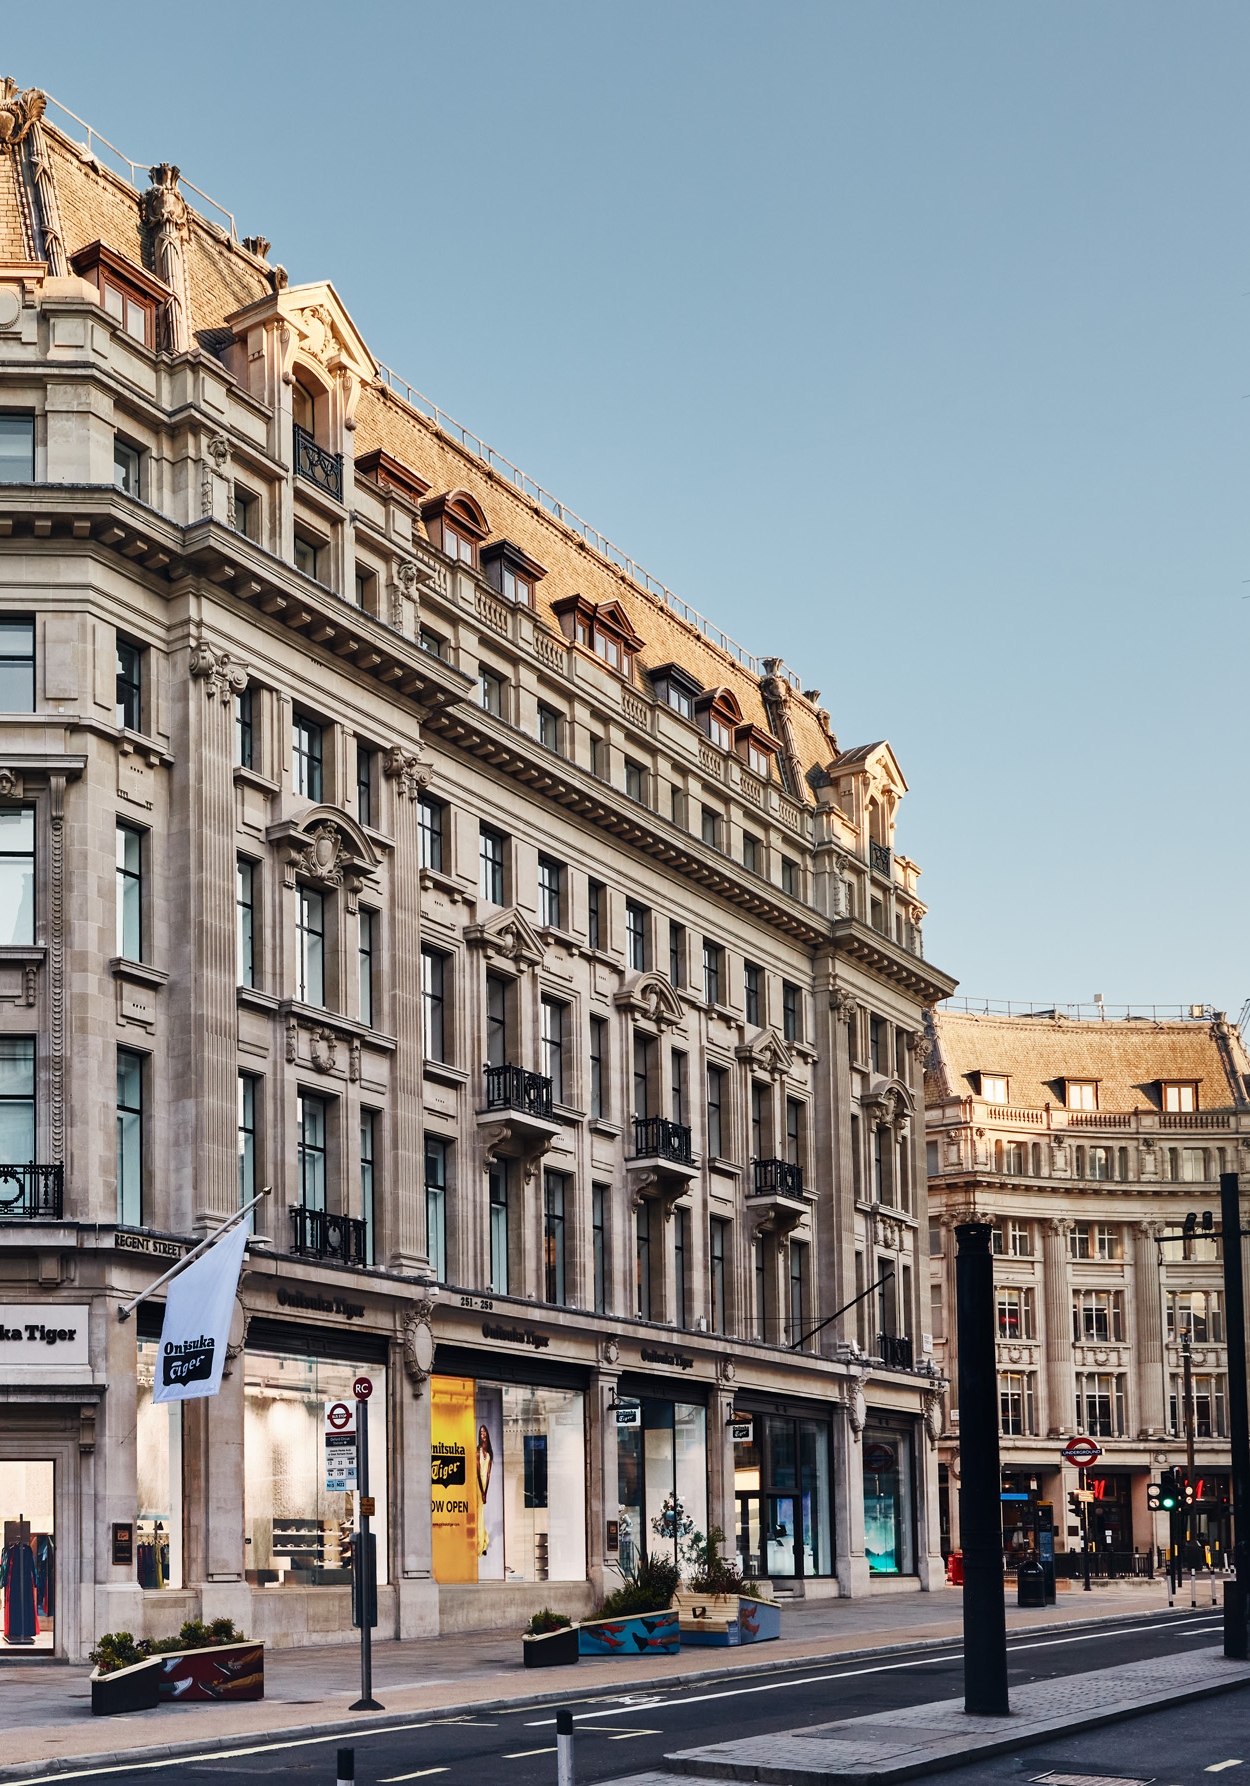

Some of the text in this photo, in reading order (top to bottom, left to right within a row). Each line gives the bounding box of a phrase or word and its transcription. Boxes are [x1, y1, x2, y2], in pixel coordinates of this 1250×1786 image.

[114, 1234, 150, 1251] REGENT
[153, 1241, 182, 1257] STREET
[461, 1297, 473, 1307] 251
[480, 1300, 493, 1310] 259
[25, 1325, 76, 1345] Tiger
[169, 1355, 206, 1380] Tiger
[356, 1383, 369, 1394] RC
[431, 1442, 465, 1455] nitsuka
[431, 1460, 460, 1480] Tiger
[431, 1500, 469, 1513] OW OPEN
